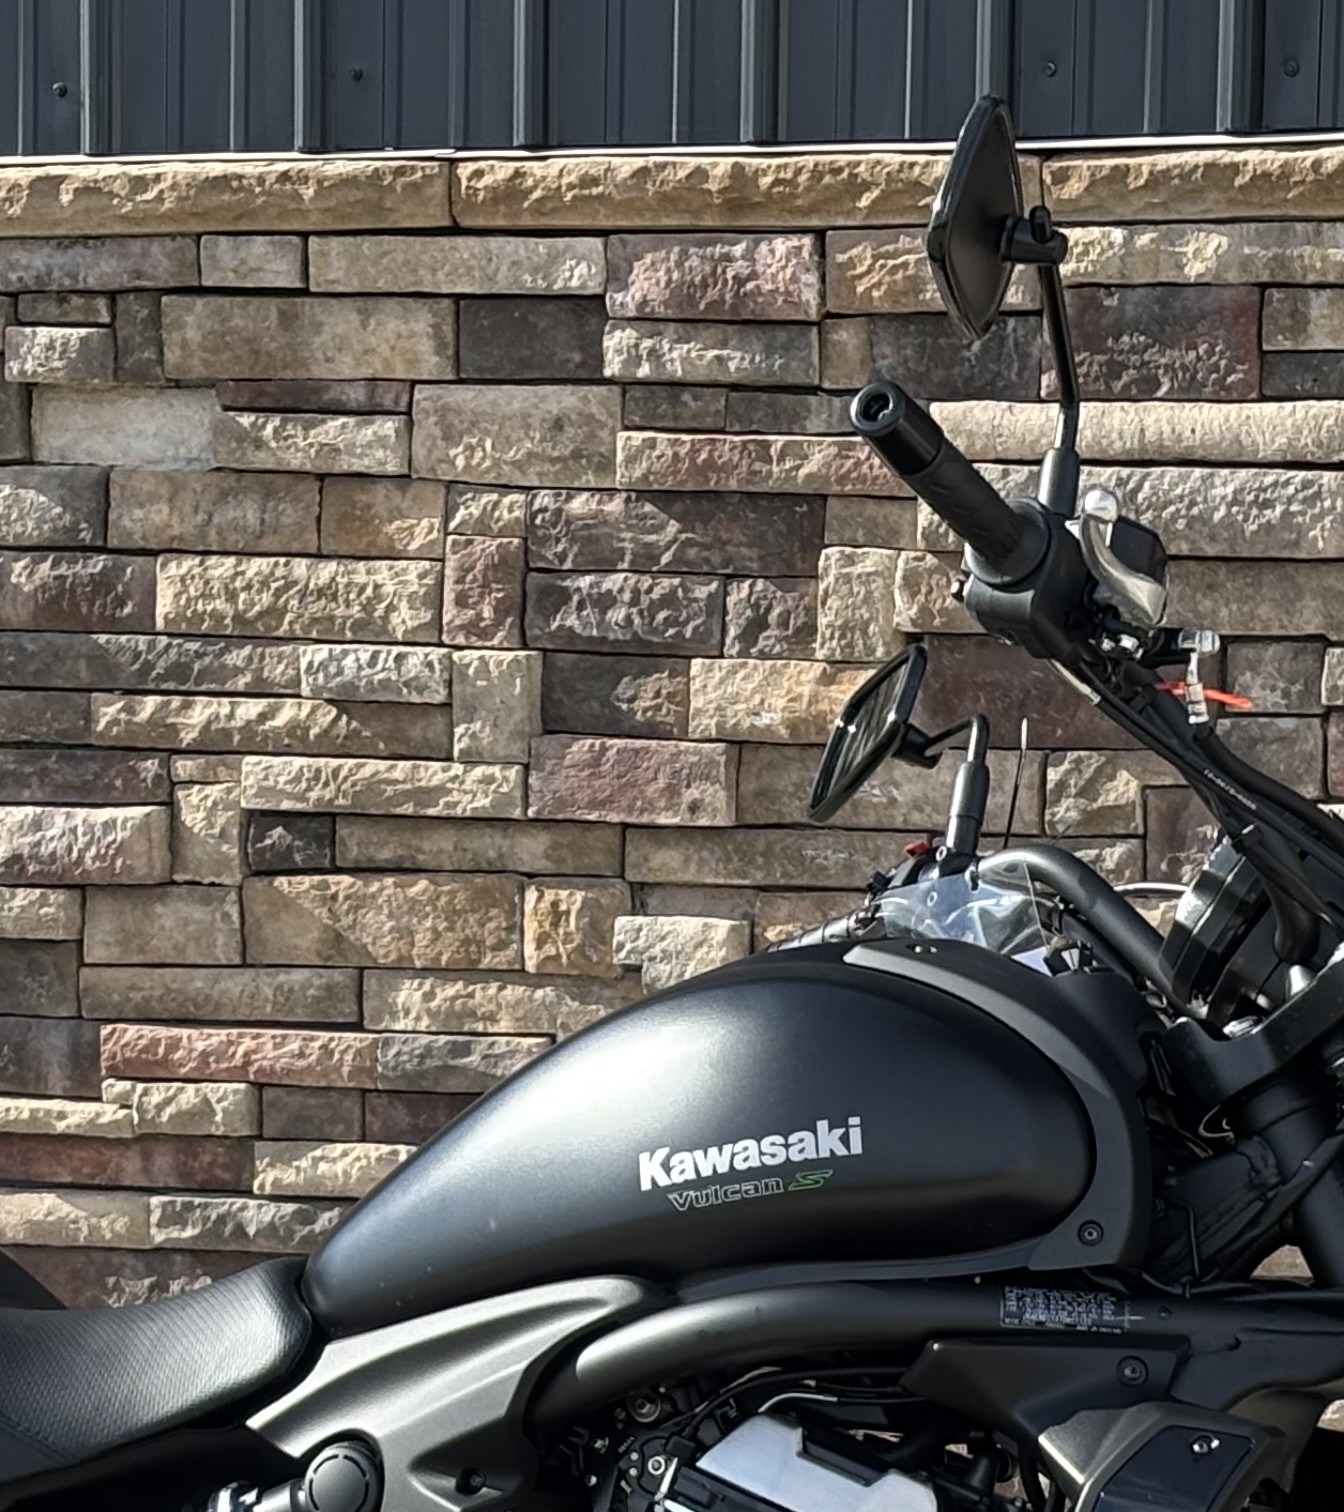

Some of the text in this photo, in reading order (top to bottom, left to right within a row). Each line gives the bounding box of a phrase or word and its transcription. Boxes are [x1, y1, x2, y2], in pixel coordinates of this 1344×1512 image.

[638, 1116, 864, 1192] Kawasaki
[667, 1169, 834, 1212] Vulcan S
